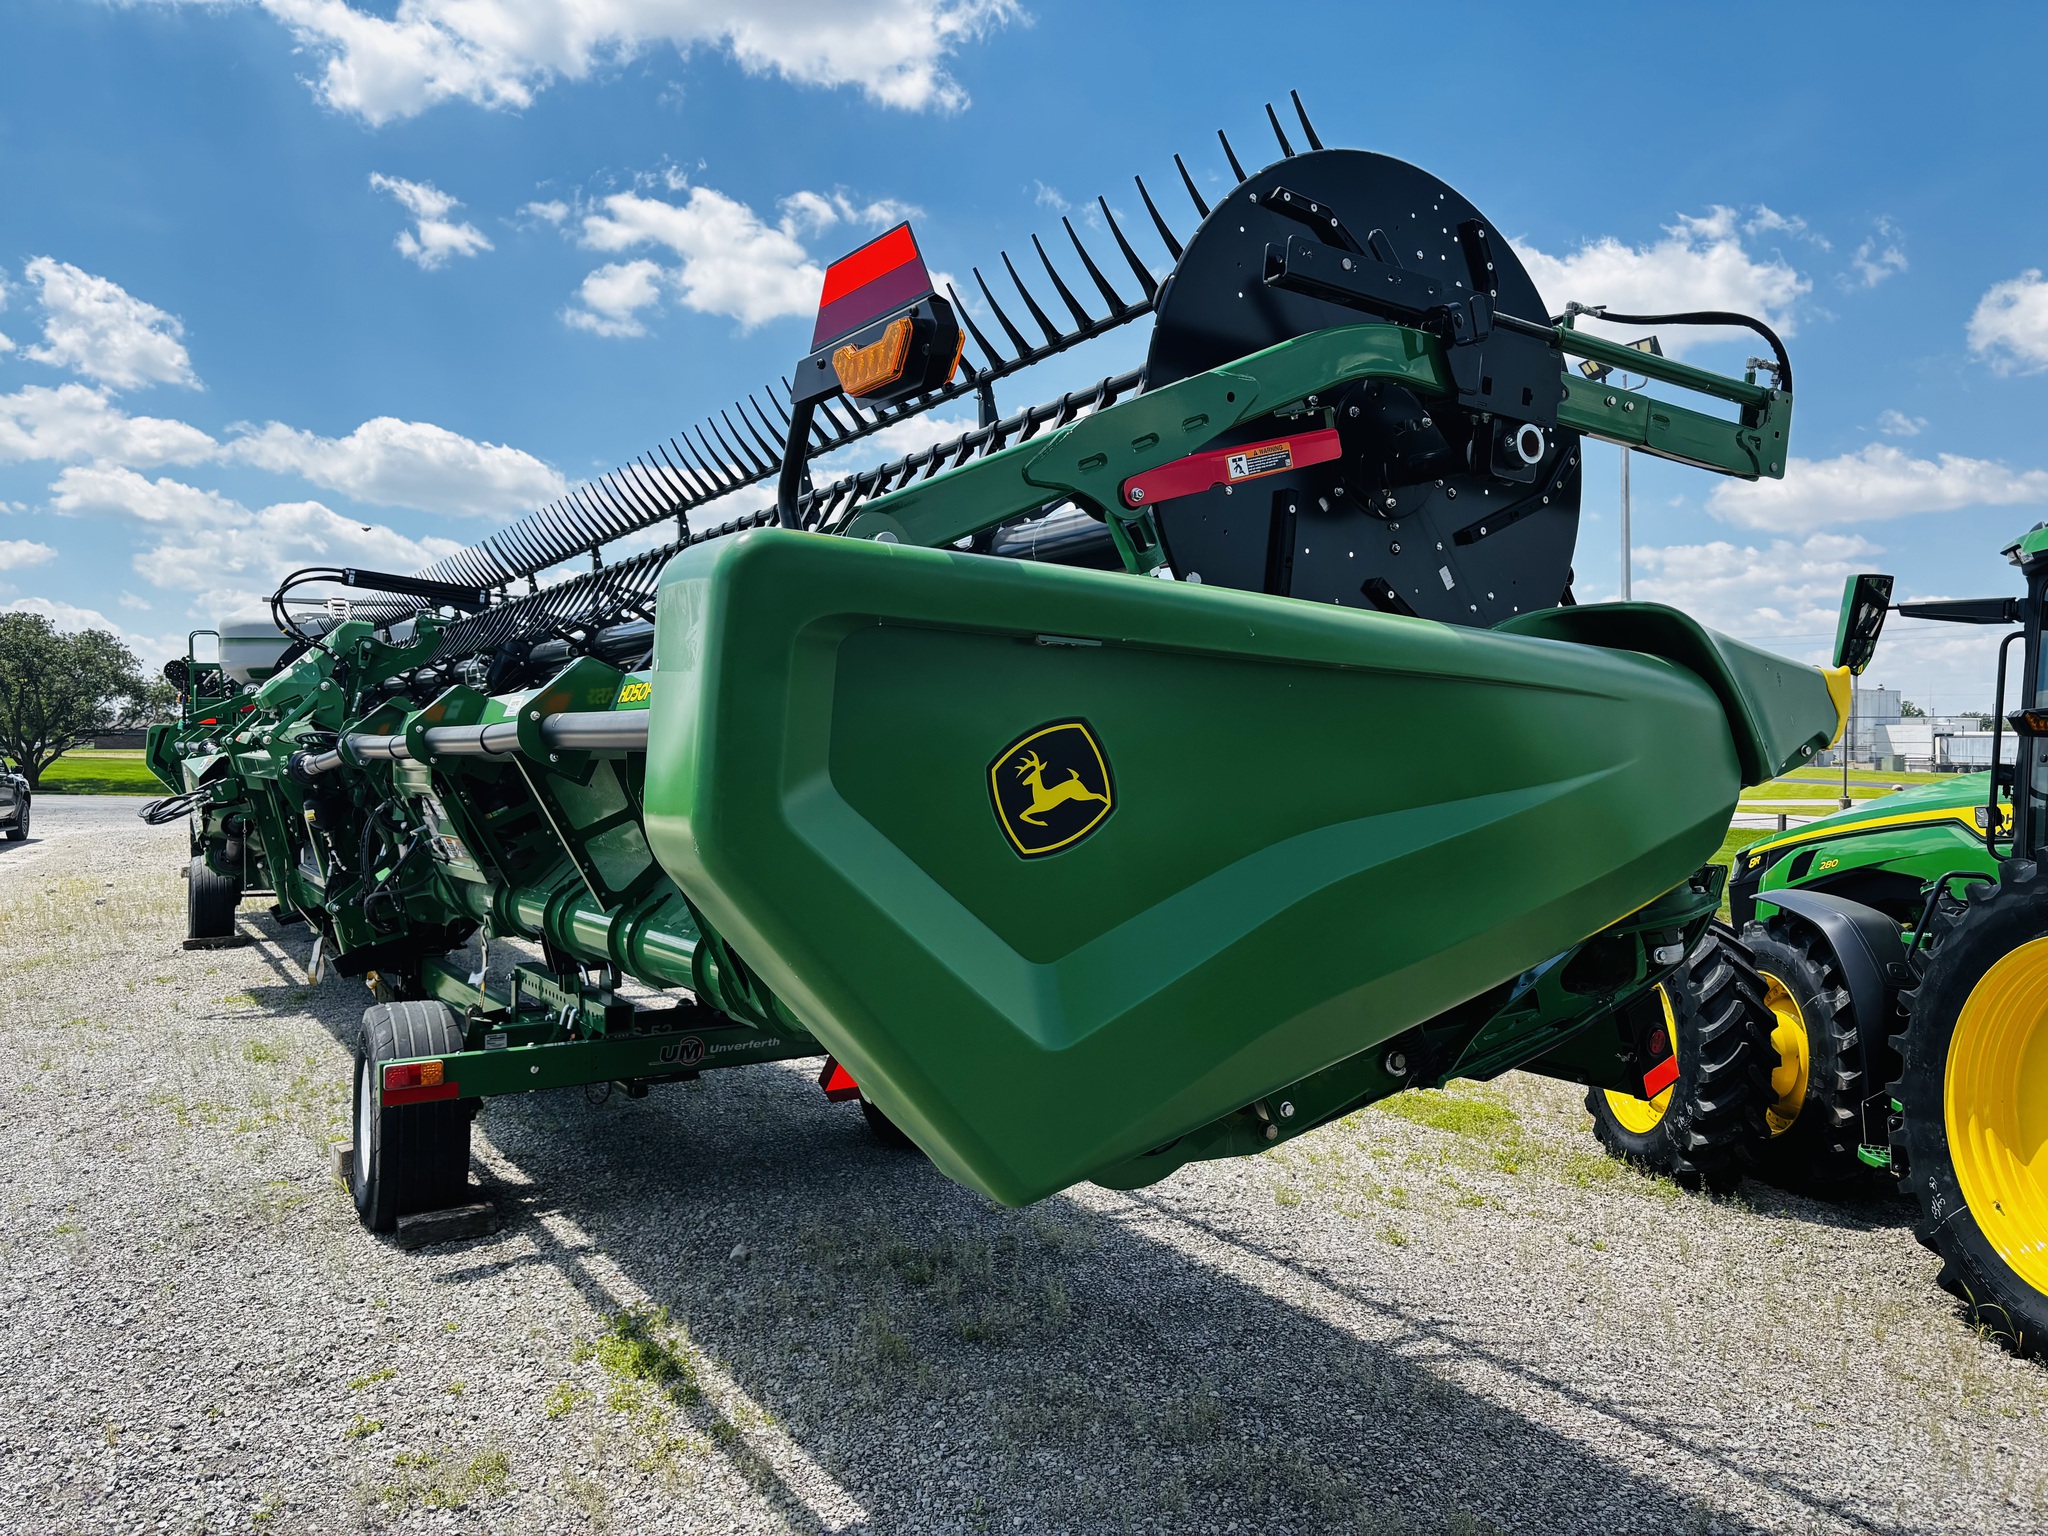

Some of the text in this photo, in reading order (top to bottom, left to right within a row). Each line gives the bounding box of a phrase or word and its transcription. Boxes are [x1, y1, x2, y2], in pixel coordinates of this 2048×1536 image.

[1259, 444, 1284, 455] WARNING
[1748, 855, 1761, 869] 8R
[1819, 858, 1839, 870] 280
[660, 1037, 780, 1063] UM Unverferth
